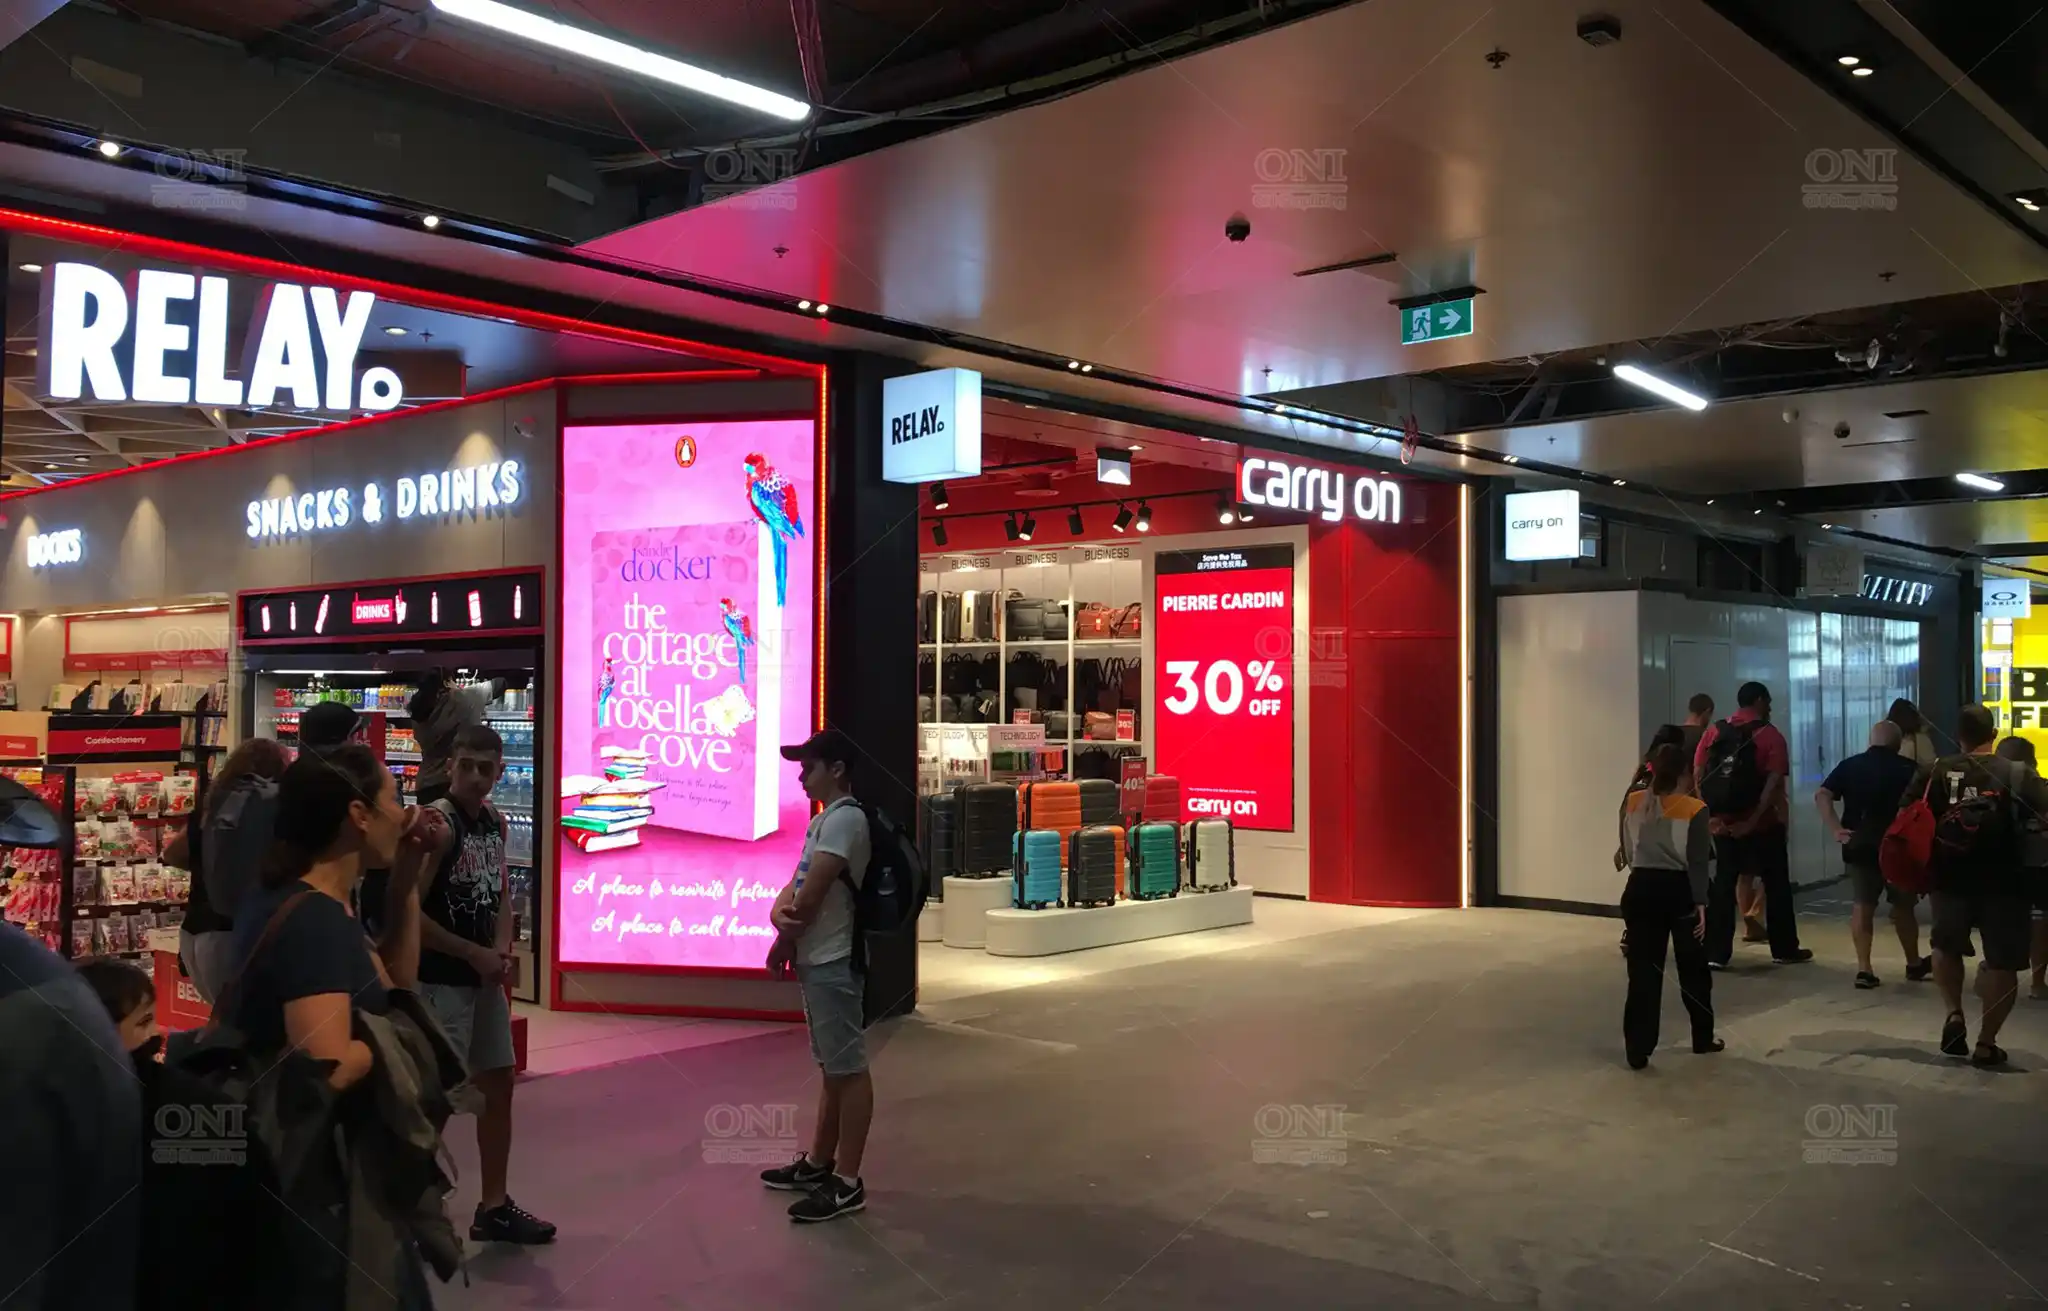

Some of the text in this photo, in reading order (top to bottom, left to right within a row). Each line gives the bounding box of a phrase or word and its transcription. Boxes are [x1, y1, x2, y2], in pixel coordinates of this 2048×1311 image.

[247, 460, 519, 537] SNACKS & DRINKS
[1242, 457, 1400, 524] carry on
[1511, 517, 1563, 530] carry on
[621, 545, 717, 582] docker
[951, 557, 990, 569] BUSINESS
[1015, 553, 1058, 566] BUSINESS
[1084, 548, 1130, 560] BUSINESS
[355, 603, 390, 619] DRINKS
[624, 592, 666, 631] the
[1163, 591, 1285, 612] PIERRE CARDIN
[603, 630, 740, 680] cottage
[620, 660, 653, 697] at
[603, 684, 715, 736] rosella
[1249, 699, 1281, 716] OFF
[84, 736, 147, 746] Confectionery
[1000, 731, 1040, 741] TECHNOLOGY
[639, 733, 731, 773] cove
[1188, 798, 1258, 816] carry on
[572, 872, 596, 895] A
[598, 874, 645, 906] place
[649, 878, 664, 900] to
[591, 910, 616, 932] A
[617, 912, 664, 943] place
[669, 916, 685, 938] to
[688, 915, 725, 937] call
